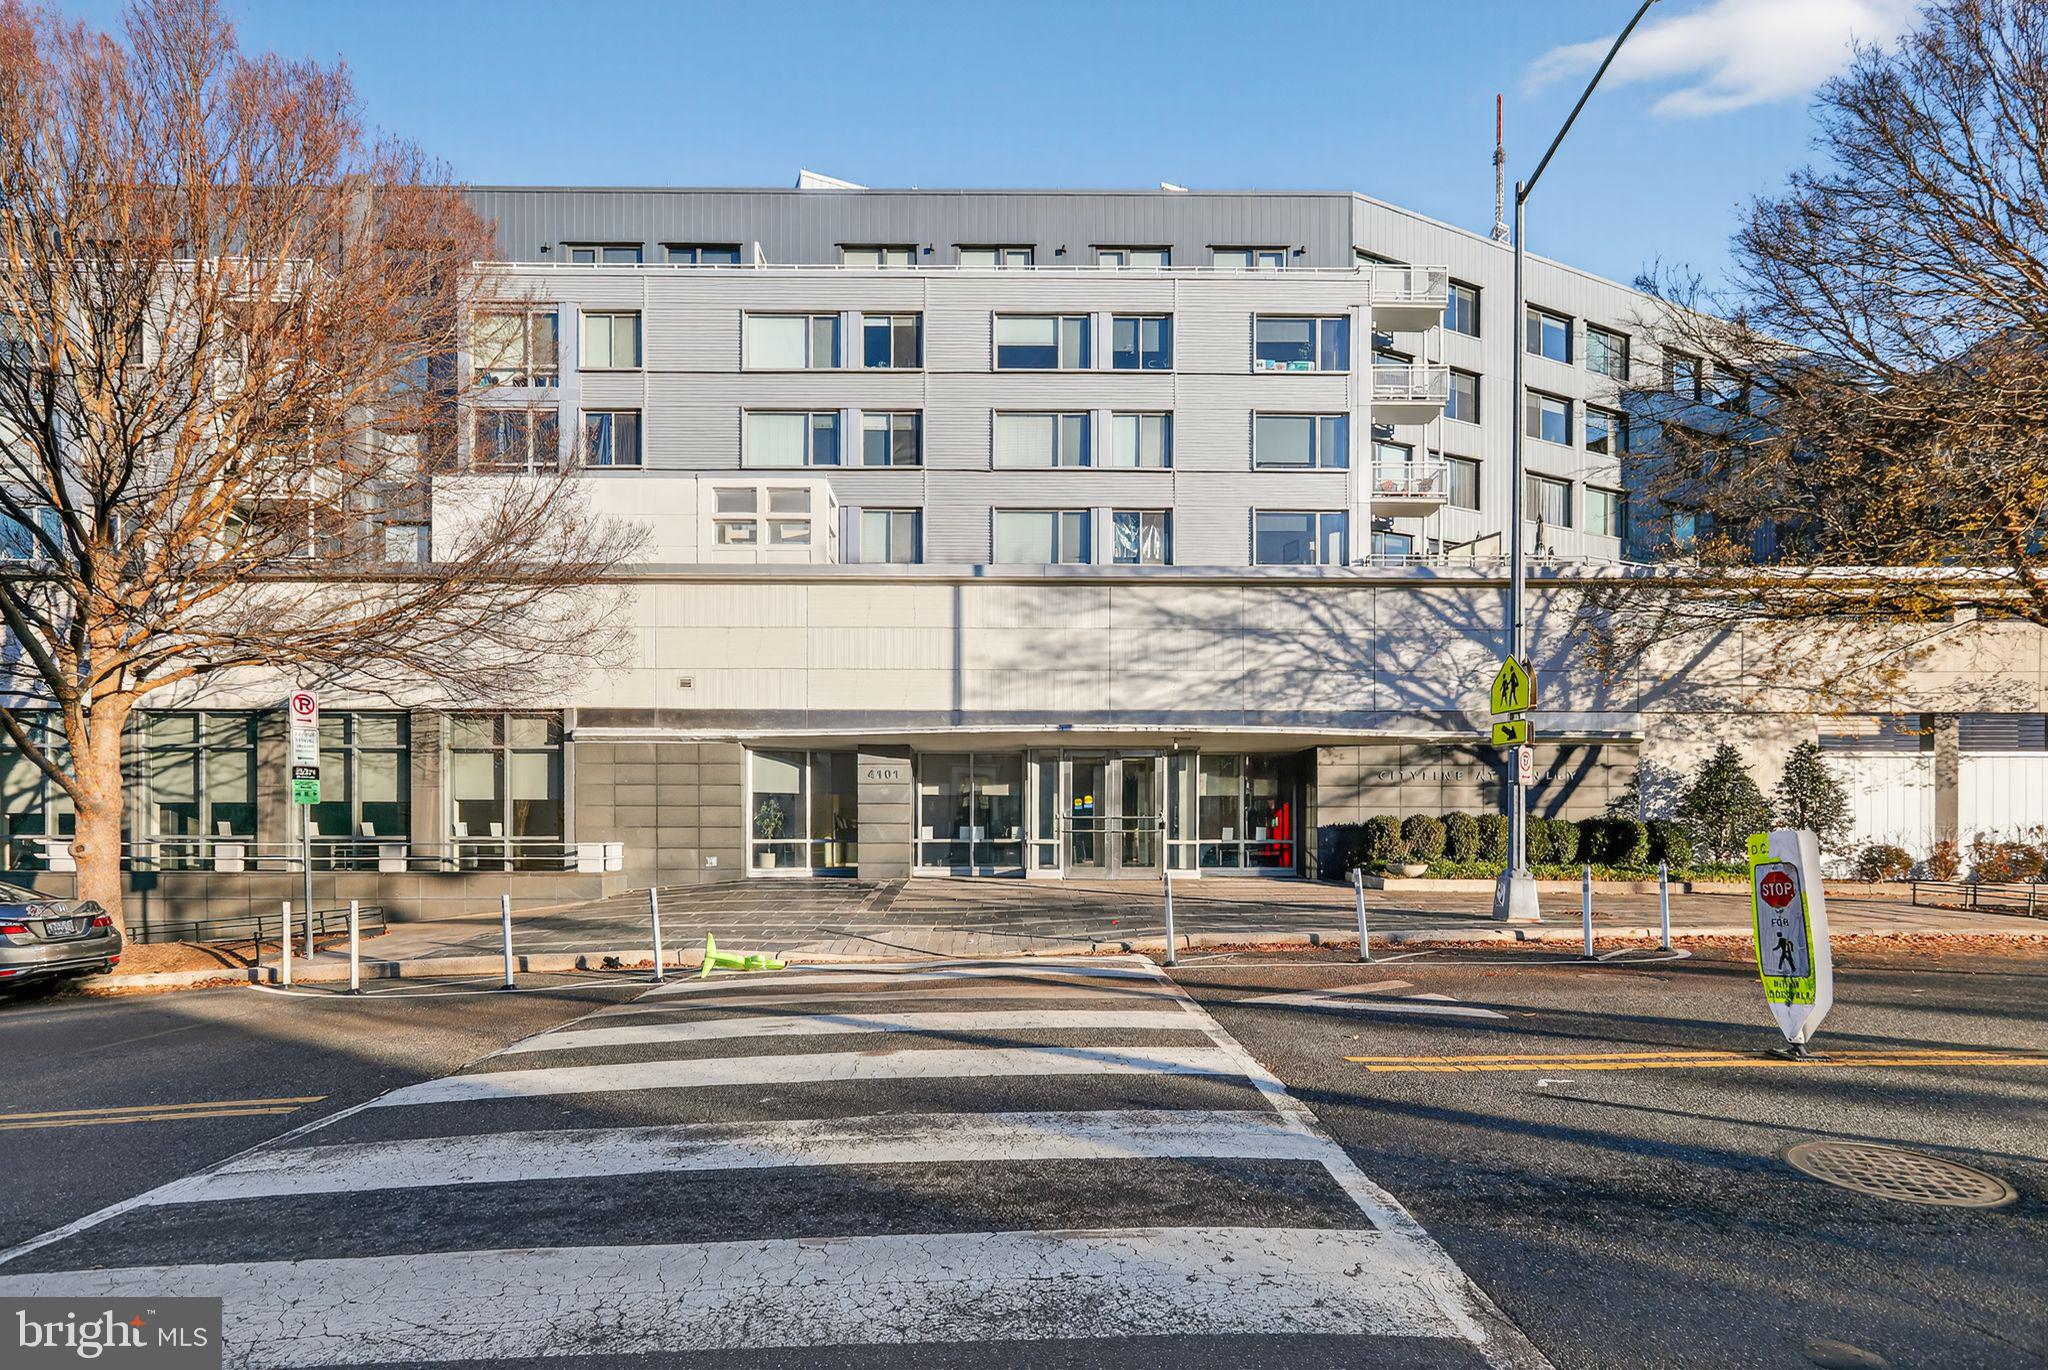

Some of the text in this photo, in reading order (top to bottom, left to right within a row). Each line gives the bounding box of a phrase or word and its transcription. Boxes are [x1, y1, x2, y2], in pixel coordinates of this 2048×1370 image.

[867, 769, 899, 779] 4101
[1378, 770, 1464, 781] CITYLINE
[1475, 770, 1496, 781] AT
[1762, 882, 1792, 897] STOP
